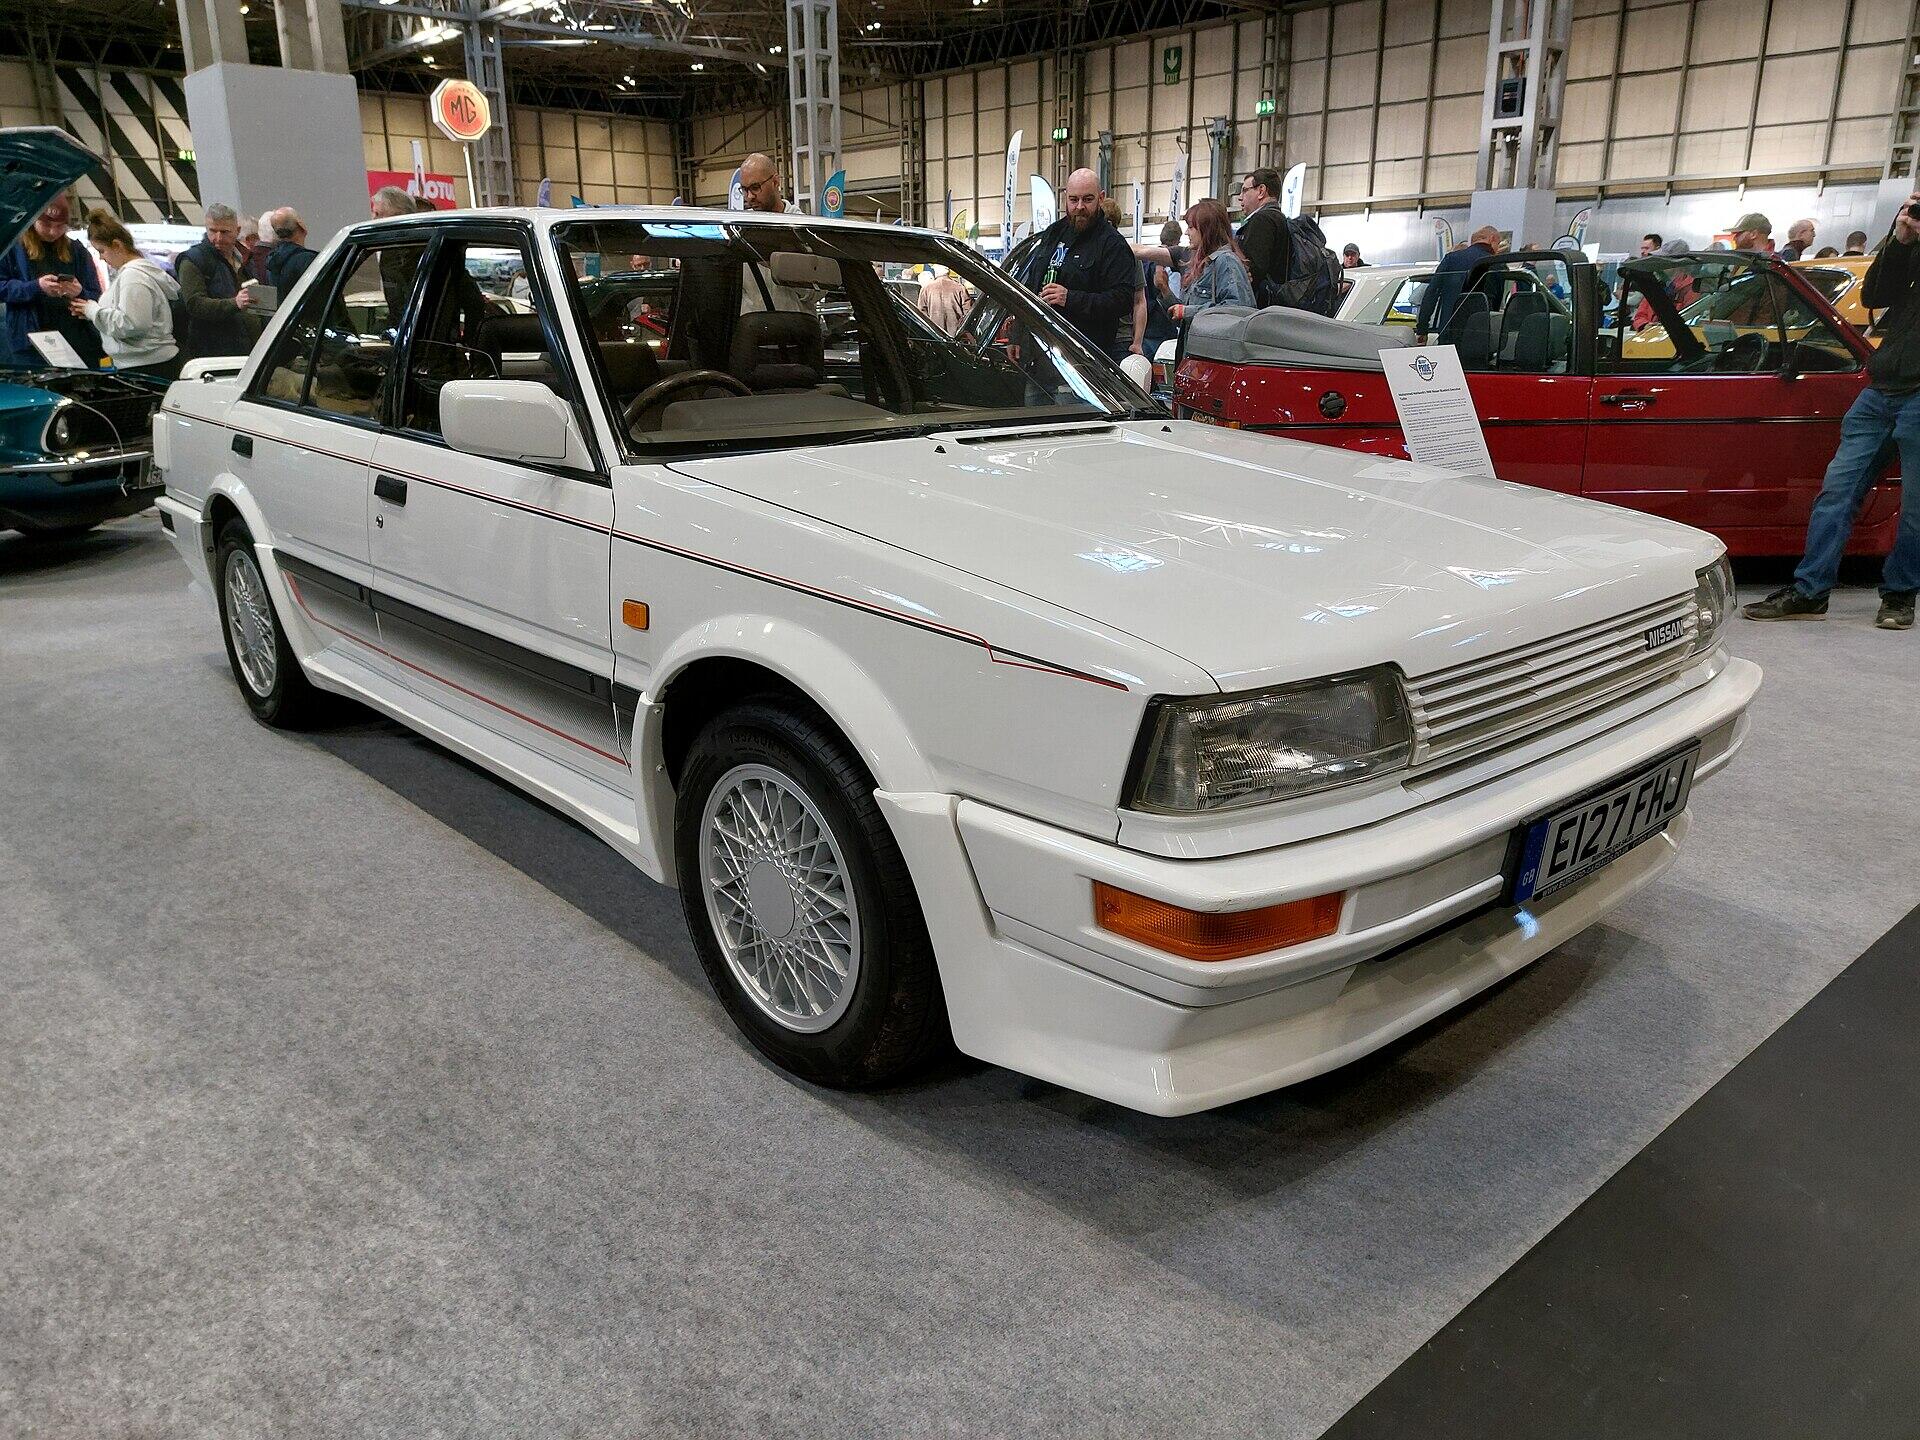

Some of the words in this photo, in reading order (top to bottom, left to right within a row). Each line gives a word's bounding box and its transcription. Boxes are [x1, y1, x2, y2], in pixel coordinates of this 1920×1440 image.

[451, 95, 476, 123] MG
[1648, 619, 1684, 648] NISSAN
[1547, 791, 1632, 879] E127
[1627, 758, 1689, 837] FHJ
[1522, 868, 1536, 887] GB
